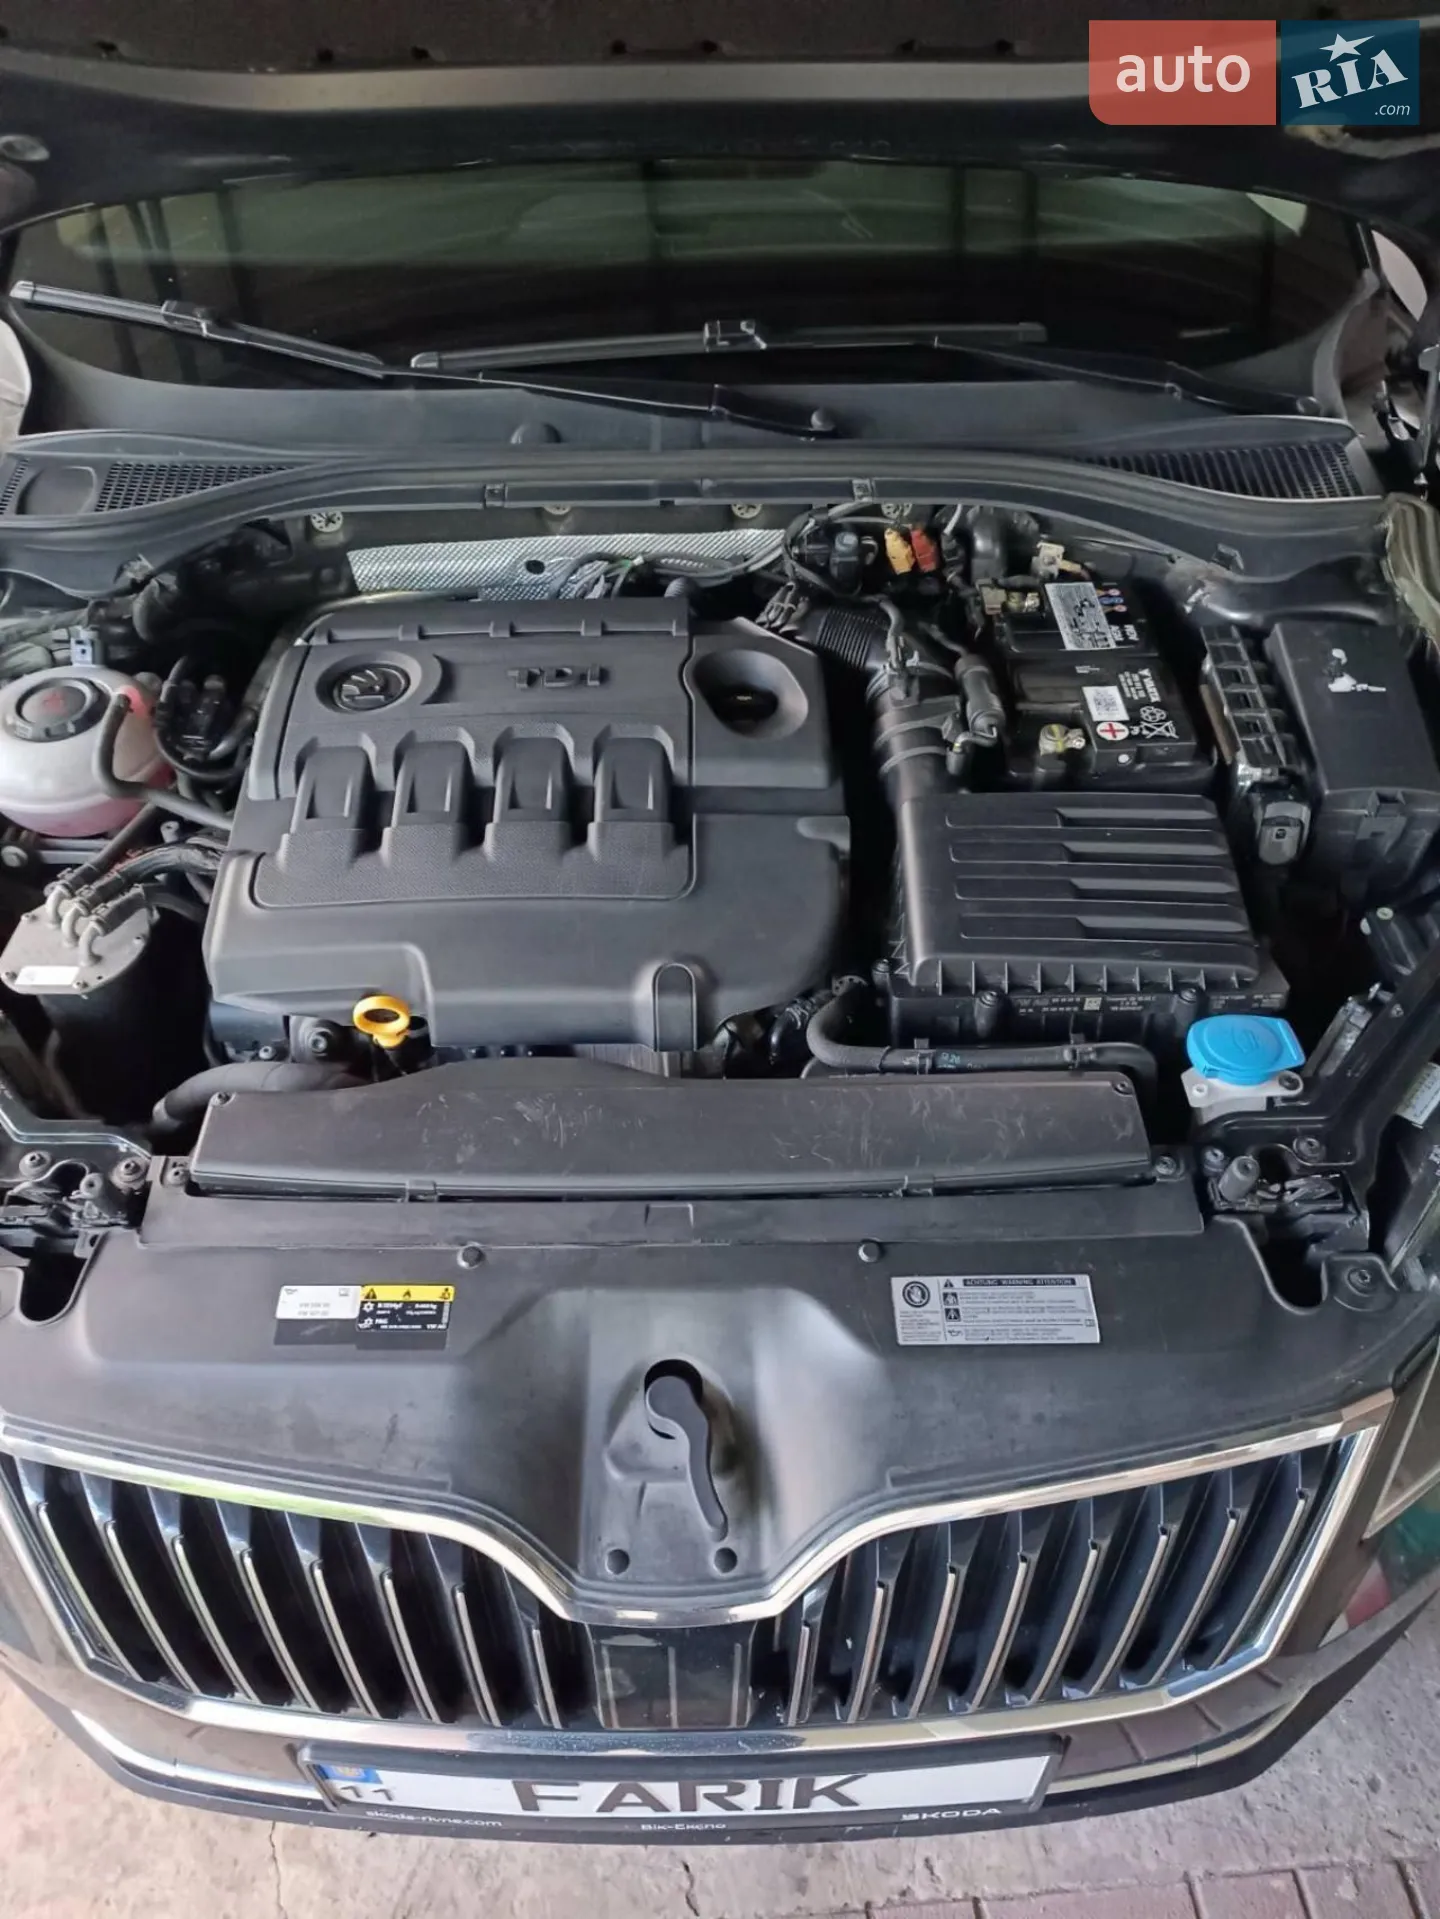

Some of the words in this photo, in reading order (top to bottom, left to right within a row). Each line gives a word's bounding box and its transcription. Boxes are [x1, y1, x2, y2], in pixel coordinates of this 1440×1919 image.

[507, 664, 602, 689] TDI
[1143, 677, 1162, 703] VARTA
[513, 1774, 868, 1813] FARIK
